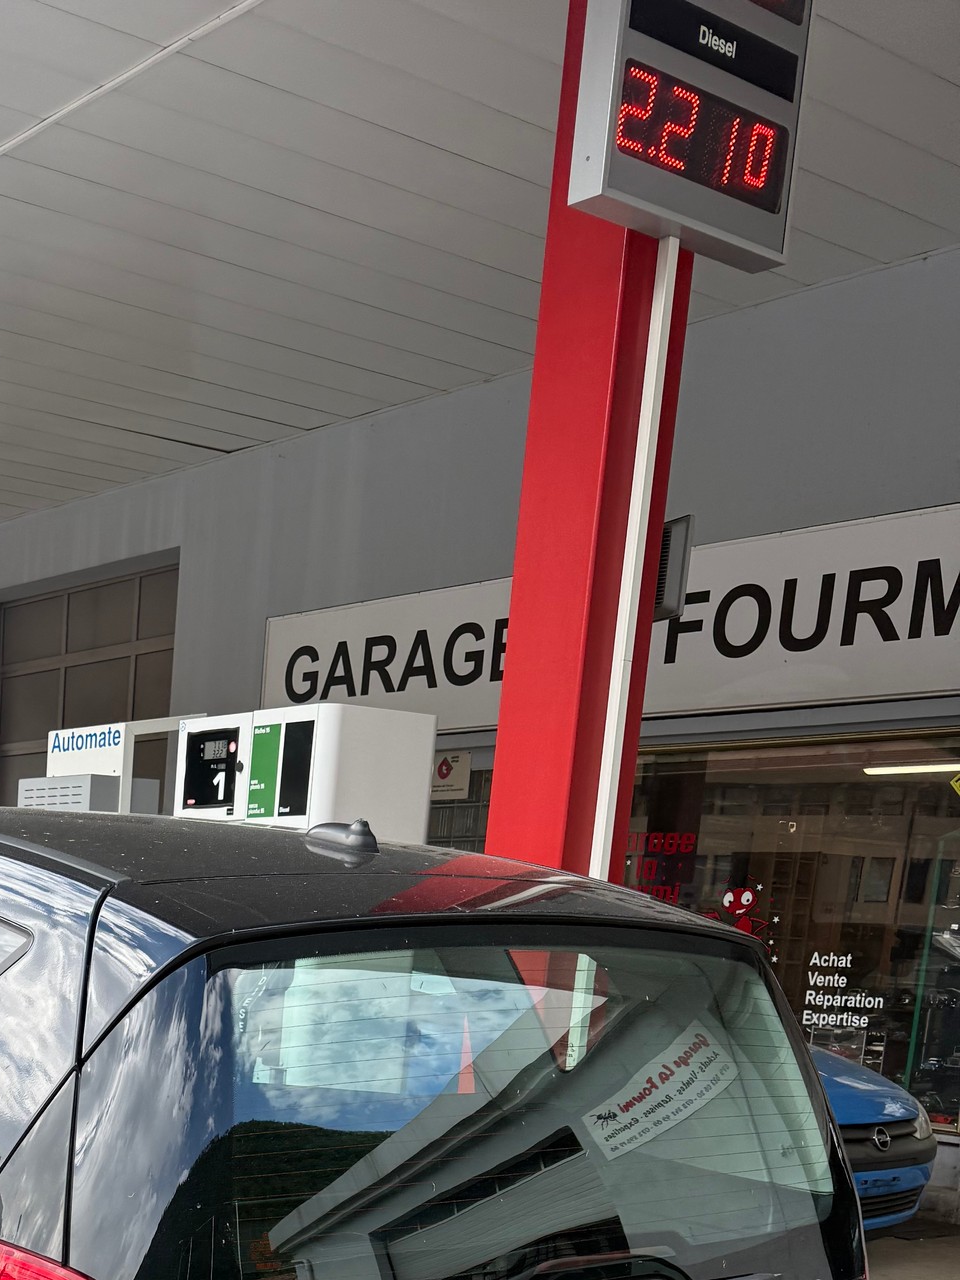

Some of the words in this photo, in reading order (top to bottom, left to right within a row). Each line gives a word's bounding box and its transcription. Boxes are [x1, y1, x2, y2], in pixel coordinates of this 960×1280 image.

[698, 24, 737, 59] Diesel
[51, 726, 121, 754] Automate
[212, 771, 226, 801] 1
[626, 832, 696, 855] arage
[809, 951, 852, 968] Achat
[807, 971, 848, 988] Vente
[804, 989, 884, 1009] Réparation
[802, 1009, 869, 1028] Expertise
